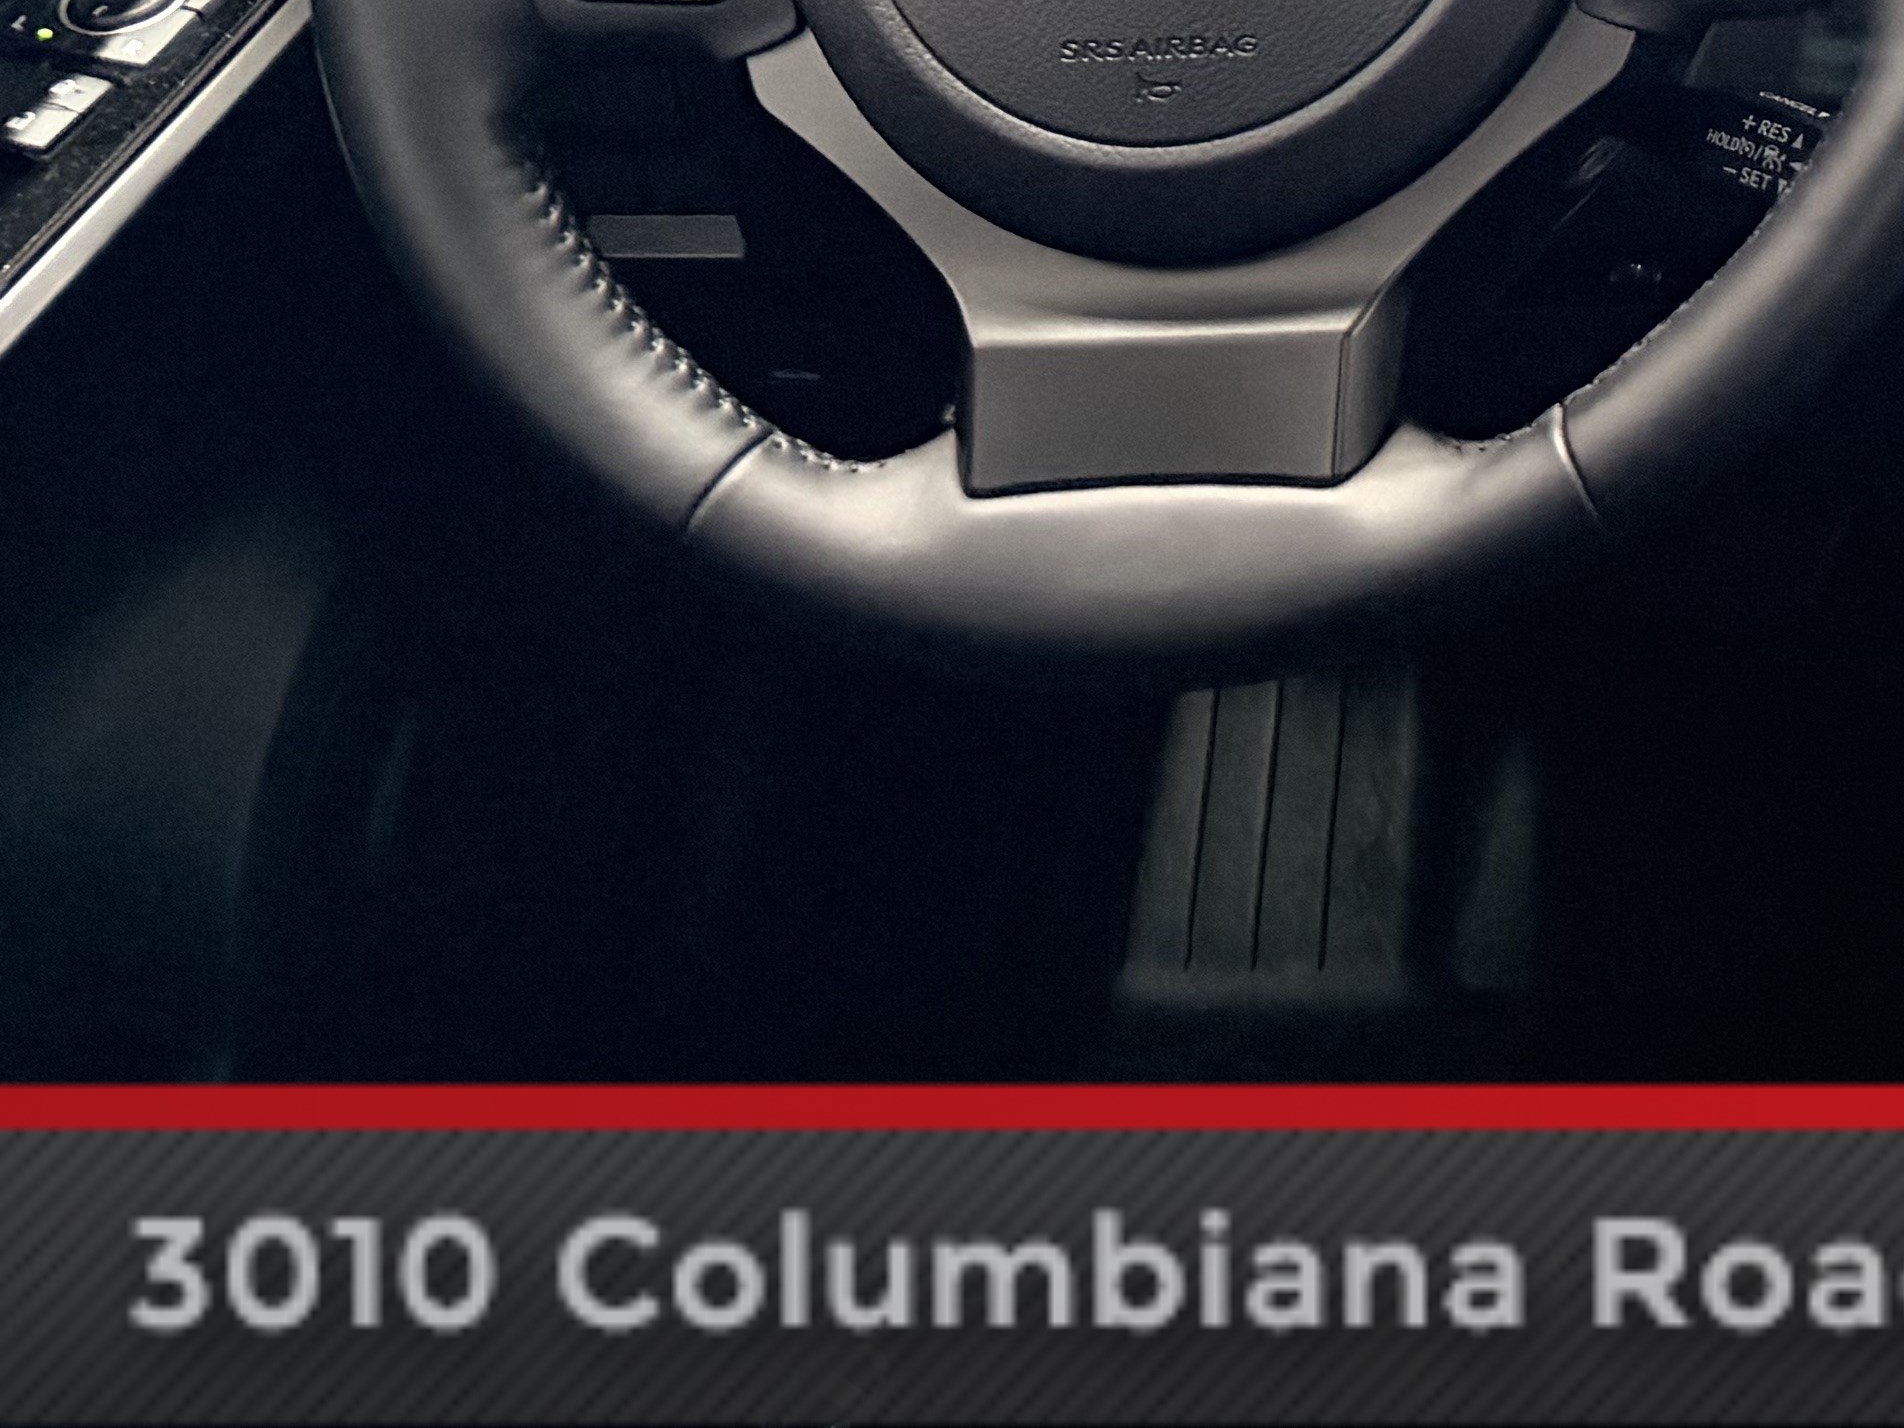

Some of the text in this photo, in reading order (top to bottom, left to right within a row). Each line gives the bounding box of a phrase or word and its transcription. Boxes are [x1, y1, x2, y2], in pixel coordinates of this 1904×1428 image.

[1061, 38, 1123, 62] SRS
[1757, 119, 1791, 143] RES
[1739, 167, 1772, 191] SET
